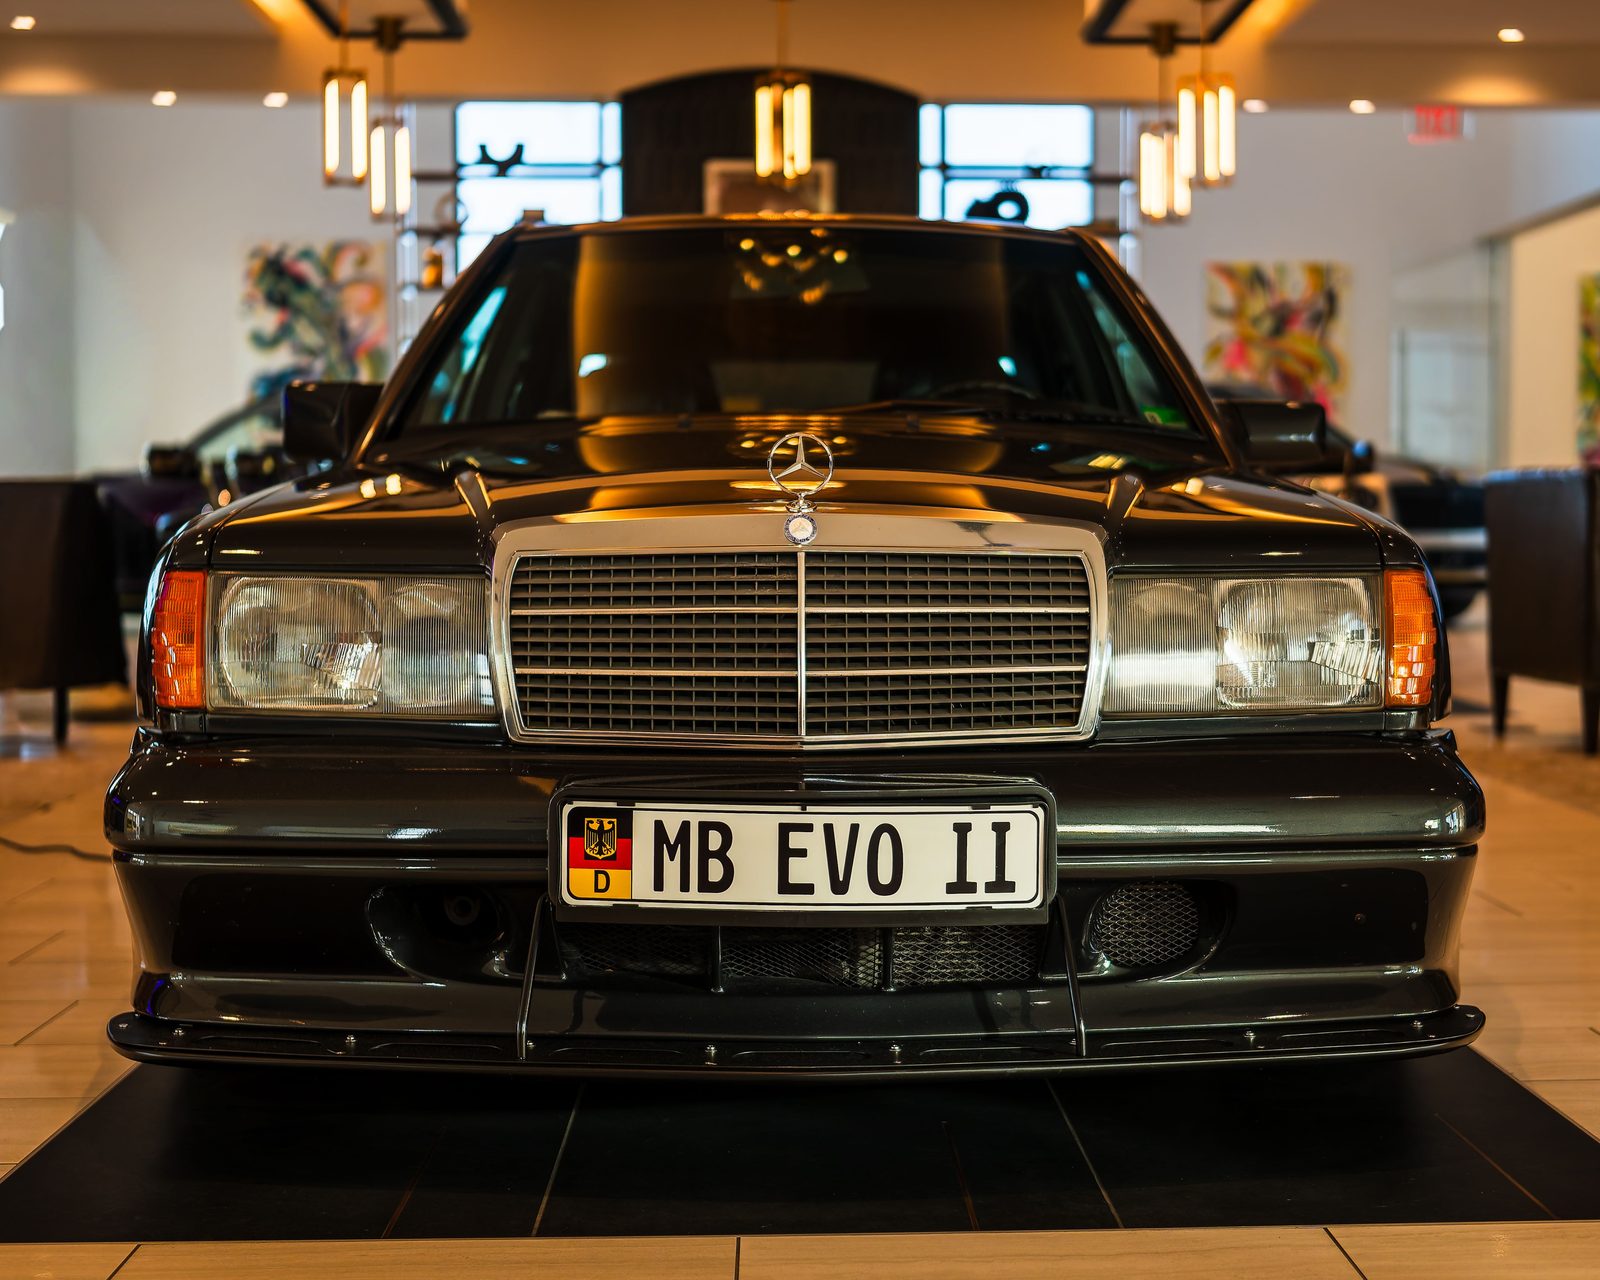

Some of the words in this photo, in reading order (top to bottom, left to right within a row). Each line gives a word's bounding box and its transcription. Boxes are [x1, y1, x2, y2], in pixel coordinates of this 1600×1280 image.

[593, 869, 611, 894] D
[653, 819, 735, 894] MB
[777, 822, 904, 897] EVO
[945, 821, 1016, 895] II
